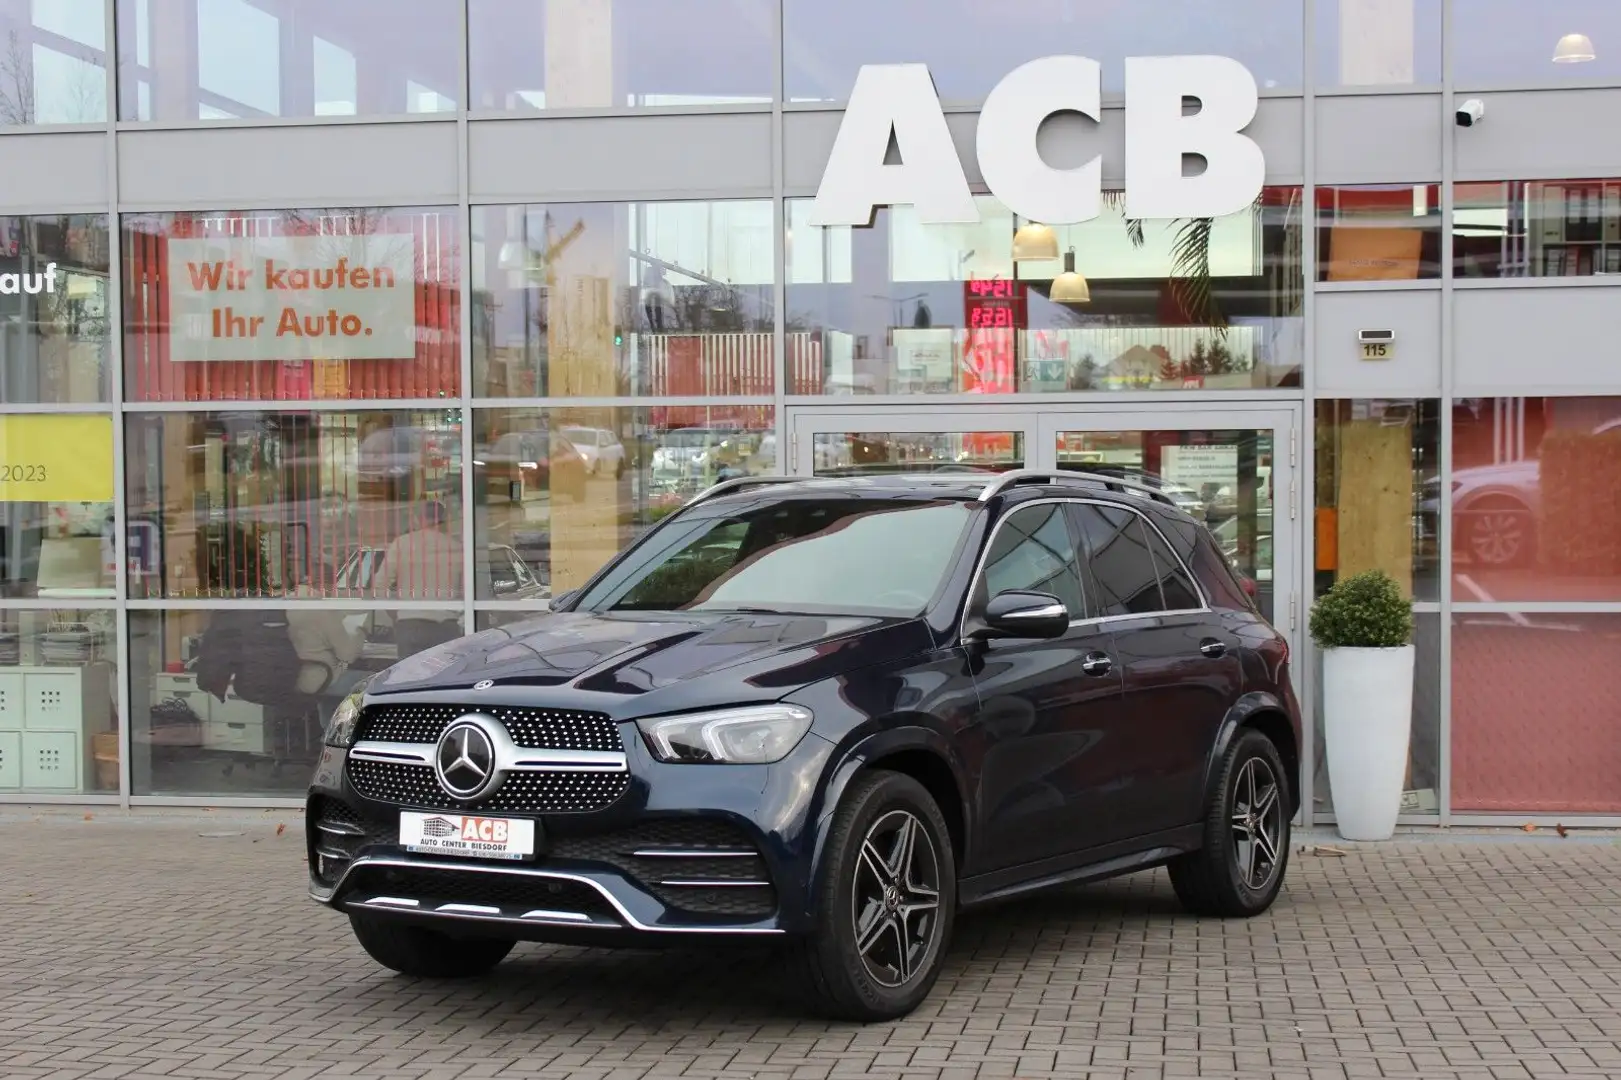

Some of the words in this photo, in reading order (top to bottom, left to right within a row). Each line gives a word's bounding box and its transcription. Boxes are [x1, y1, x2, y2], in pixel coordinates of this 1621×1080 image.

[809, 55, 1265, 227] ACB
[0, 262, 57, 294] auf
[187, 260, 250, 291] Wir
[265, 256, 395, 290] kaufen
[212, 306, 265, 339] Ihr
[276, 307, 373, 337] Auto.
[1363, 343, 1387, 357] 115
[0, 464, 47, 482] 2023
[461, 818, 508, 842] ACB
[420, 838, 438, 846] AUTO
[441, 840, 467, 849] CENTER
[471, 842, 508, 852] BIESDORF
